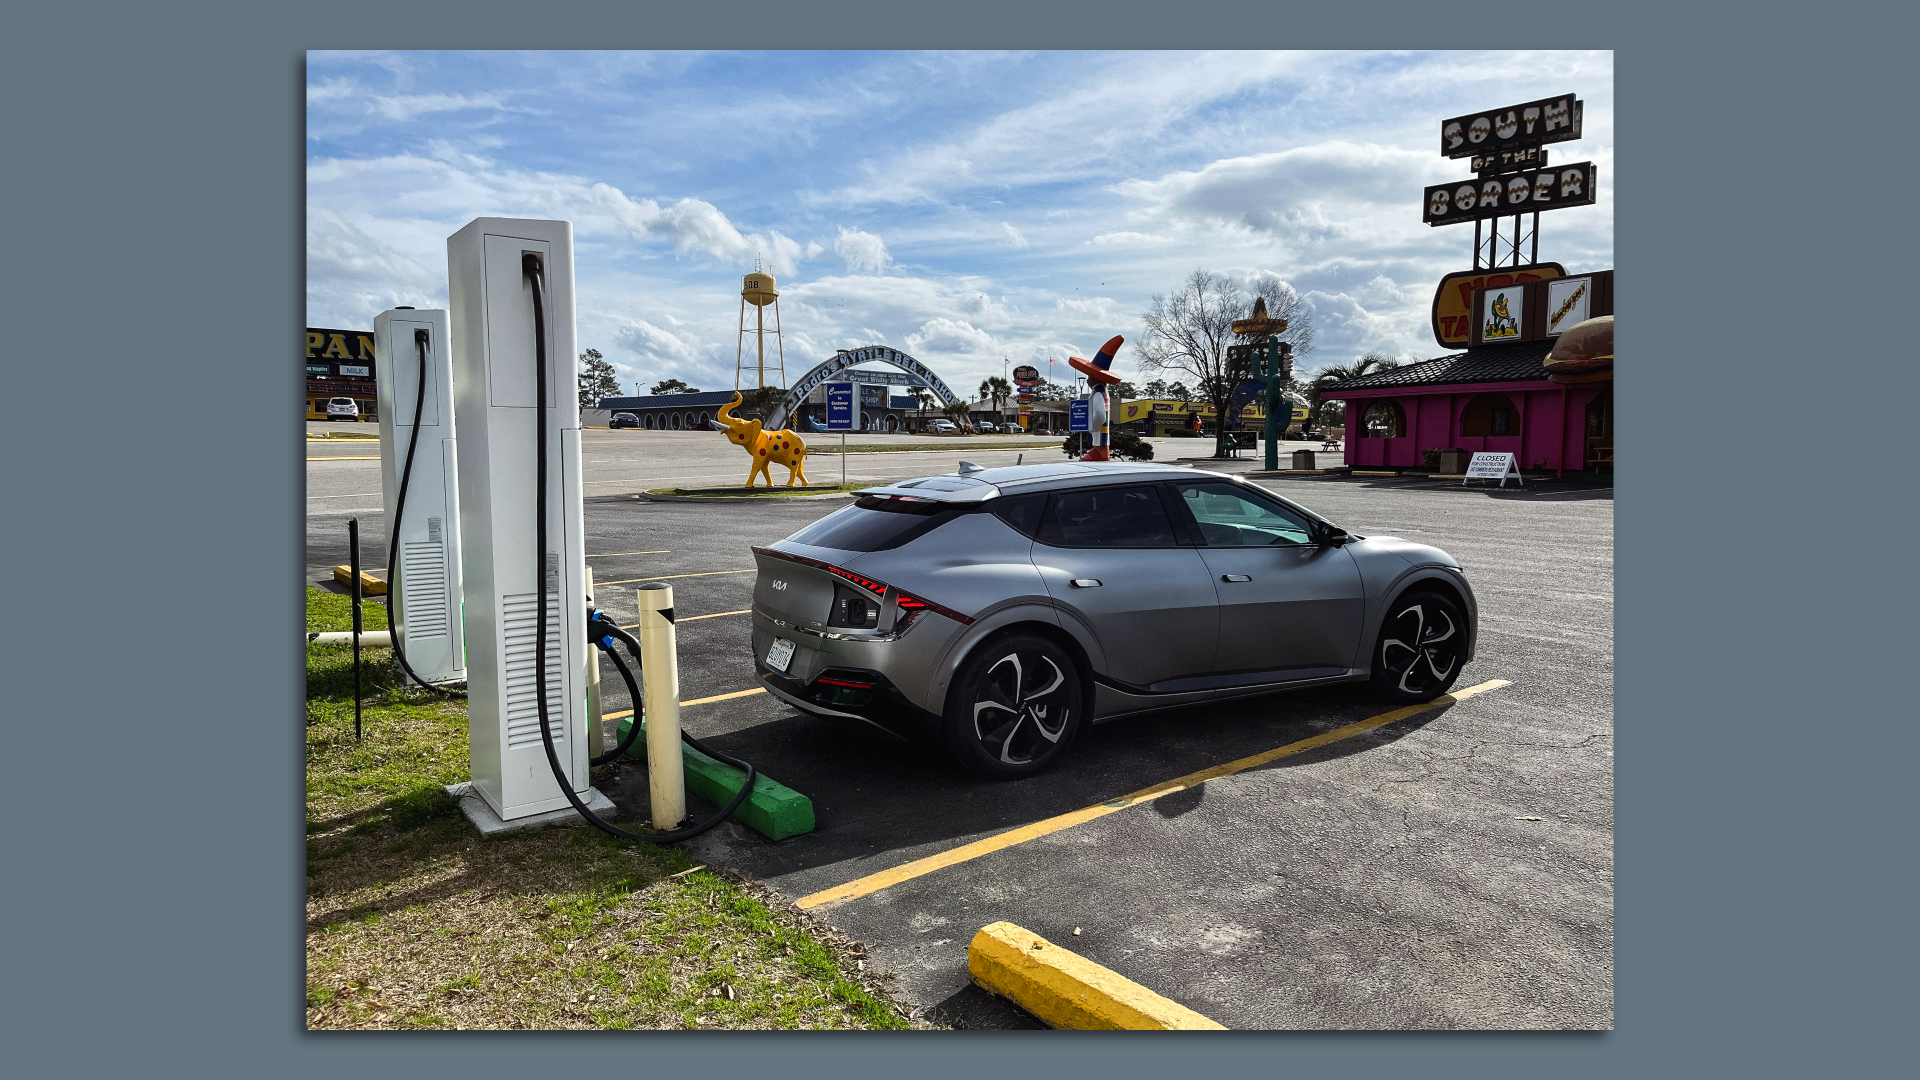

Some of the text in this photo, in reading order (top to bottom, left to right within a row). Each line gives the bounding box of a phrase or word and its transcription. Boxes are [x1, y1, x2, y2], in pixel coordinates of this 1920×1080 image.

[1444, 99, 1571, 149] SOUTH
[1472, 148, 1537, 169] OF THE
[1429, 168, 1584, 216] BORDER
[796, 364, 837, 399] Pedro's
[840, 349, 891, 367] MYRTLE
[894, 352, 933, 383] BEAH
[865, 396, 880, 404] SHOP
[990, 639, 1054, 657] CONTINENTAL
